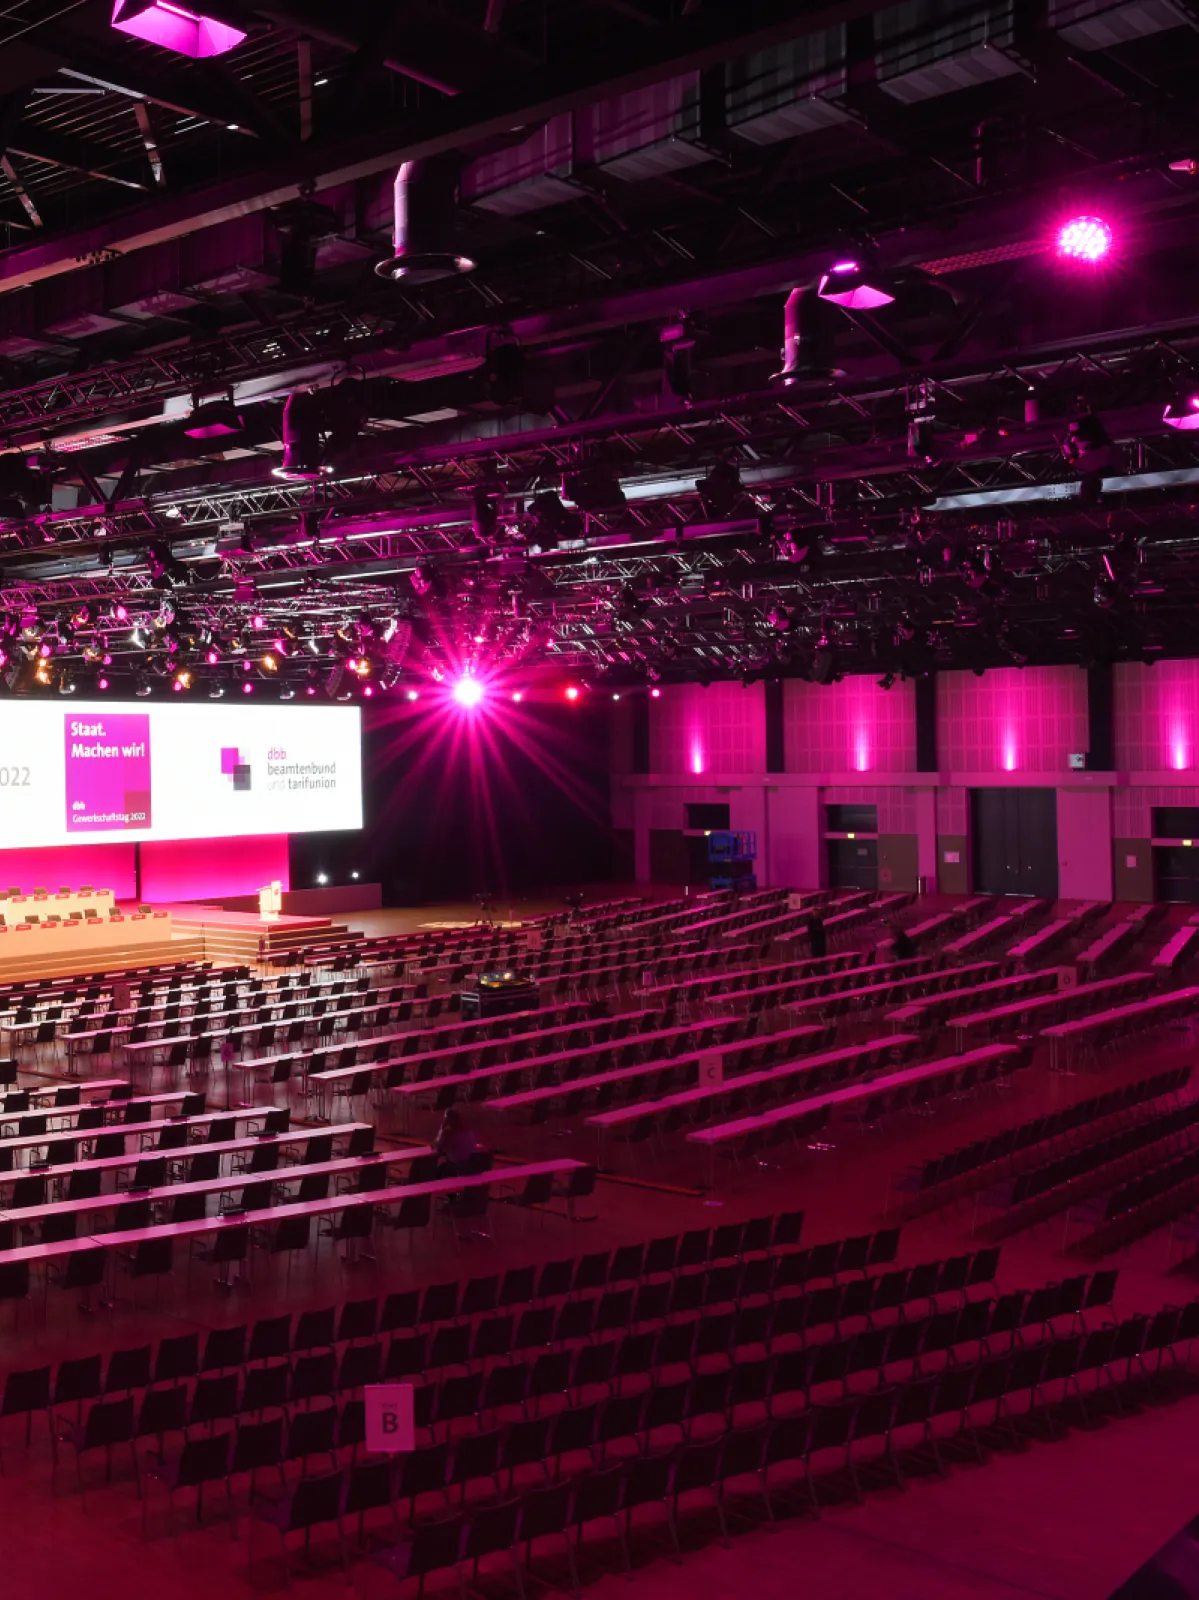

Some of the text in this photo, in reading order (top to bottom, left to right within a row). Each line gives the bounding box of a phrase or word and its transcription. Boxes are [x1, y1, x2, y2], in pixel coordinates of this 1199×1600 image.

[71, 720, 107, 737] Staat.
[71, 742, 145, 758] Machen wir!
[267, 746, 287, 761] dbb
[267, 761, 336, 776] beamtenbund
[288, 776, 336, 790] tarifunion
[72, 812, 131, 824] Gewerkschaftstag
[382, 1412, 399, 1434] B
